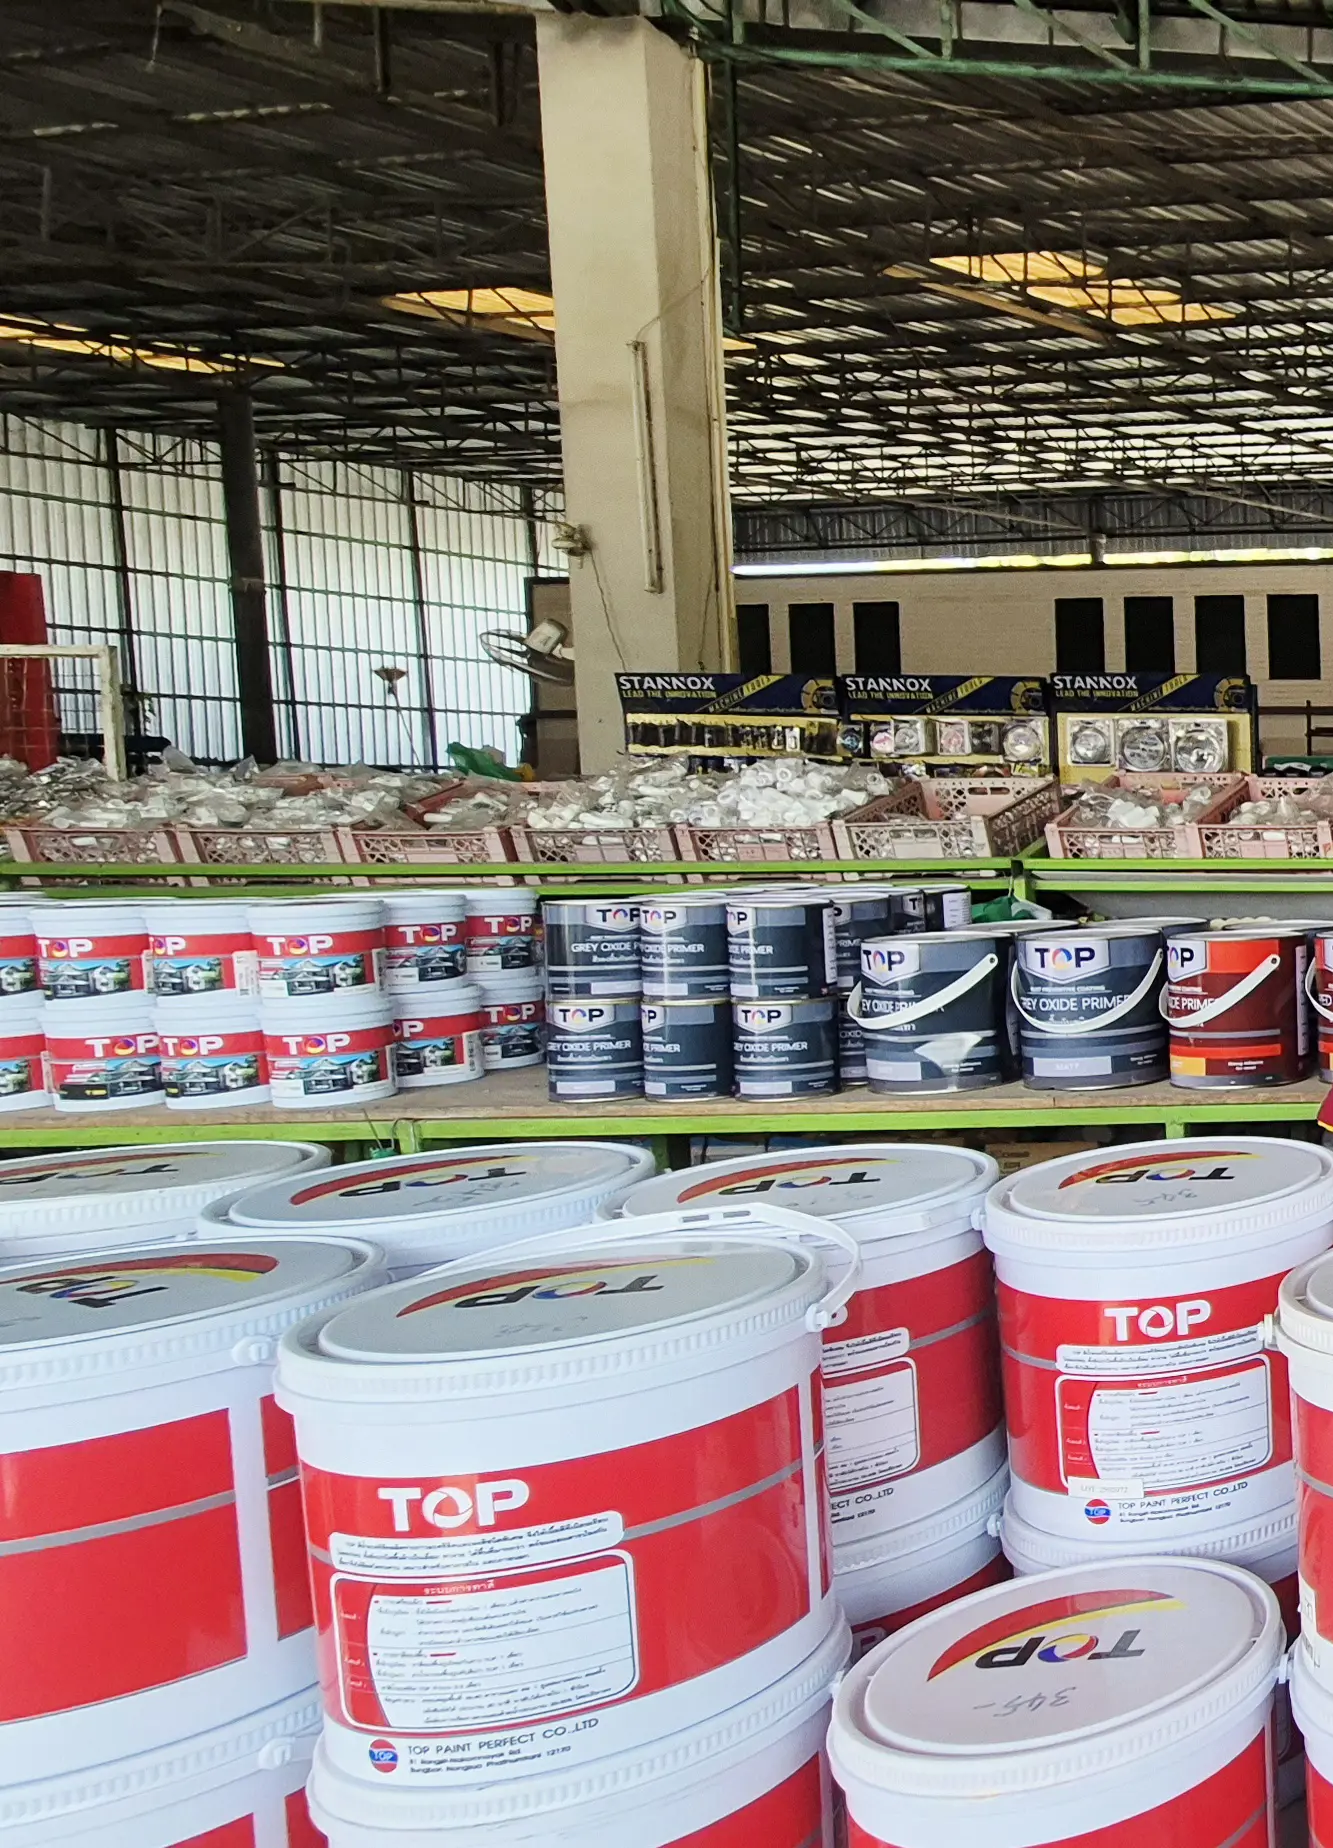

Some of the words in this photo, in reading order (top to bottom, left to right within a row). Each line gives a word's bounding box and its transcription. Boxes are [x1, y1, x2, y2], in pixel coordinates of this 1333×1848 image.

[618, 675, 715, 690] STANNOX
[845, 677, 932, 692] STANNOX
[1053, 675, 1138, 690] STANNOX
[484, 915, 532, 933] TOP
[596, 908, 640, 923] TOP
[642, 910, 677, 924] TOP
[398, 924, 457, 944] TOP
[38, 938, 93, 959] TOP
[266, 935, 333, 955] TOP
[571, 943, 599, 953] GREY
[668, 943, 705, 954] PRIMER
[863, 949, 905, 971] TOP
[1034, 947, 1095, 970] TOP
[1167, 946, 1194, 968] OP
[484, 1003, 536, 1023] TOP
[1039, 998, 1076, 1011] OXIDE
[559, 1008, 604, 1023] TOP
[741, 1009, 781, 1023] TOP
[85, 1035, 160, 1058] TOP
[162, 1035, 224, 1056] TOP
[282, 1033, 350, 1055] TOP
[593, 1040, 631, 1050] PRIMER
[771, 1041, 807, 1051] PRIMER
[338, 1166, 527, 1197] TOP
[718, 1171, 881, 1195] TOP
[1096, 1167, 1235, 1183] TOP
[15, 1275, 170, 1309] TOP
[454, 1275, 665, 1308] TOP
[1104, 1299, 1211, 1341] TOP
[378, 1478, 530, 1532] TOP
[1118, 1502, 1136, 1510] TOP
[1171, 1493, 1209, 1505] PERFECT
[974, 1629, 1146, 1669] TOP
[408, 1745, 430, 1755] TOP
[436, 1742, 471, 1754] PAINT
[479, 1732, 535, 1751] PERFECT
[372, 1751, 394, 1762] TOP
